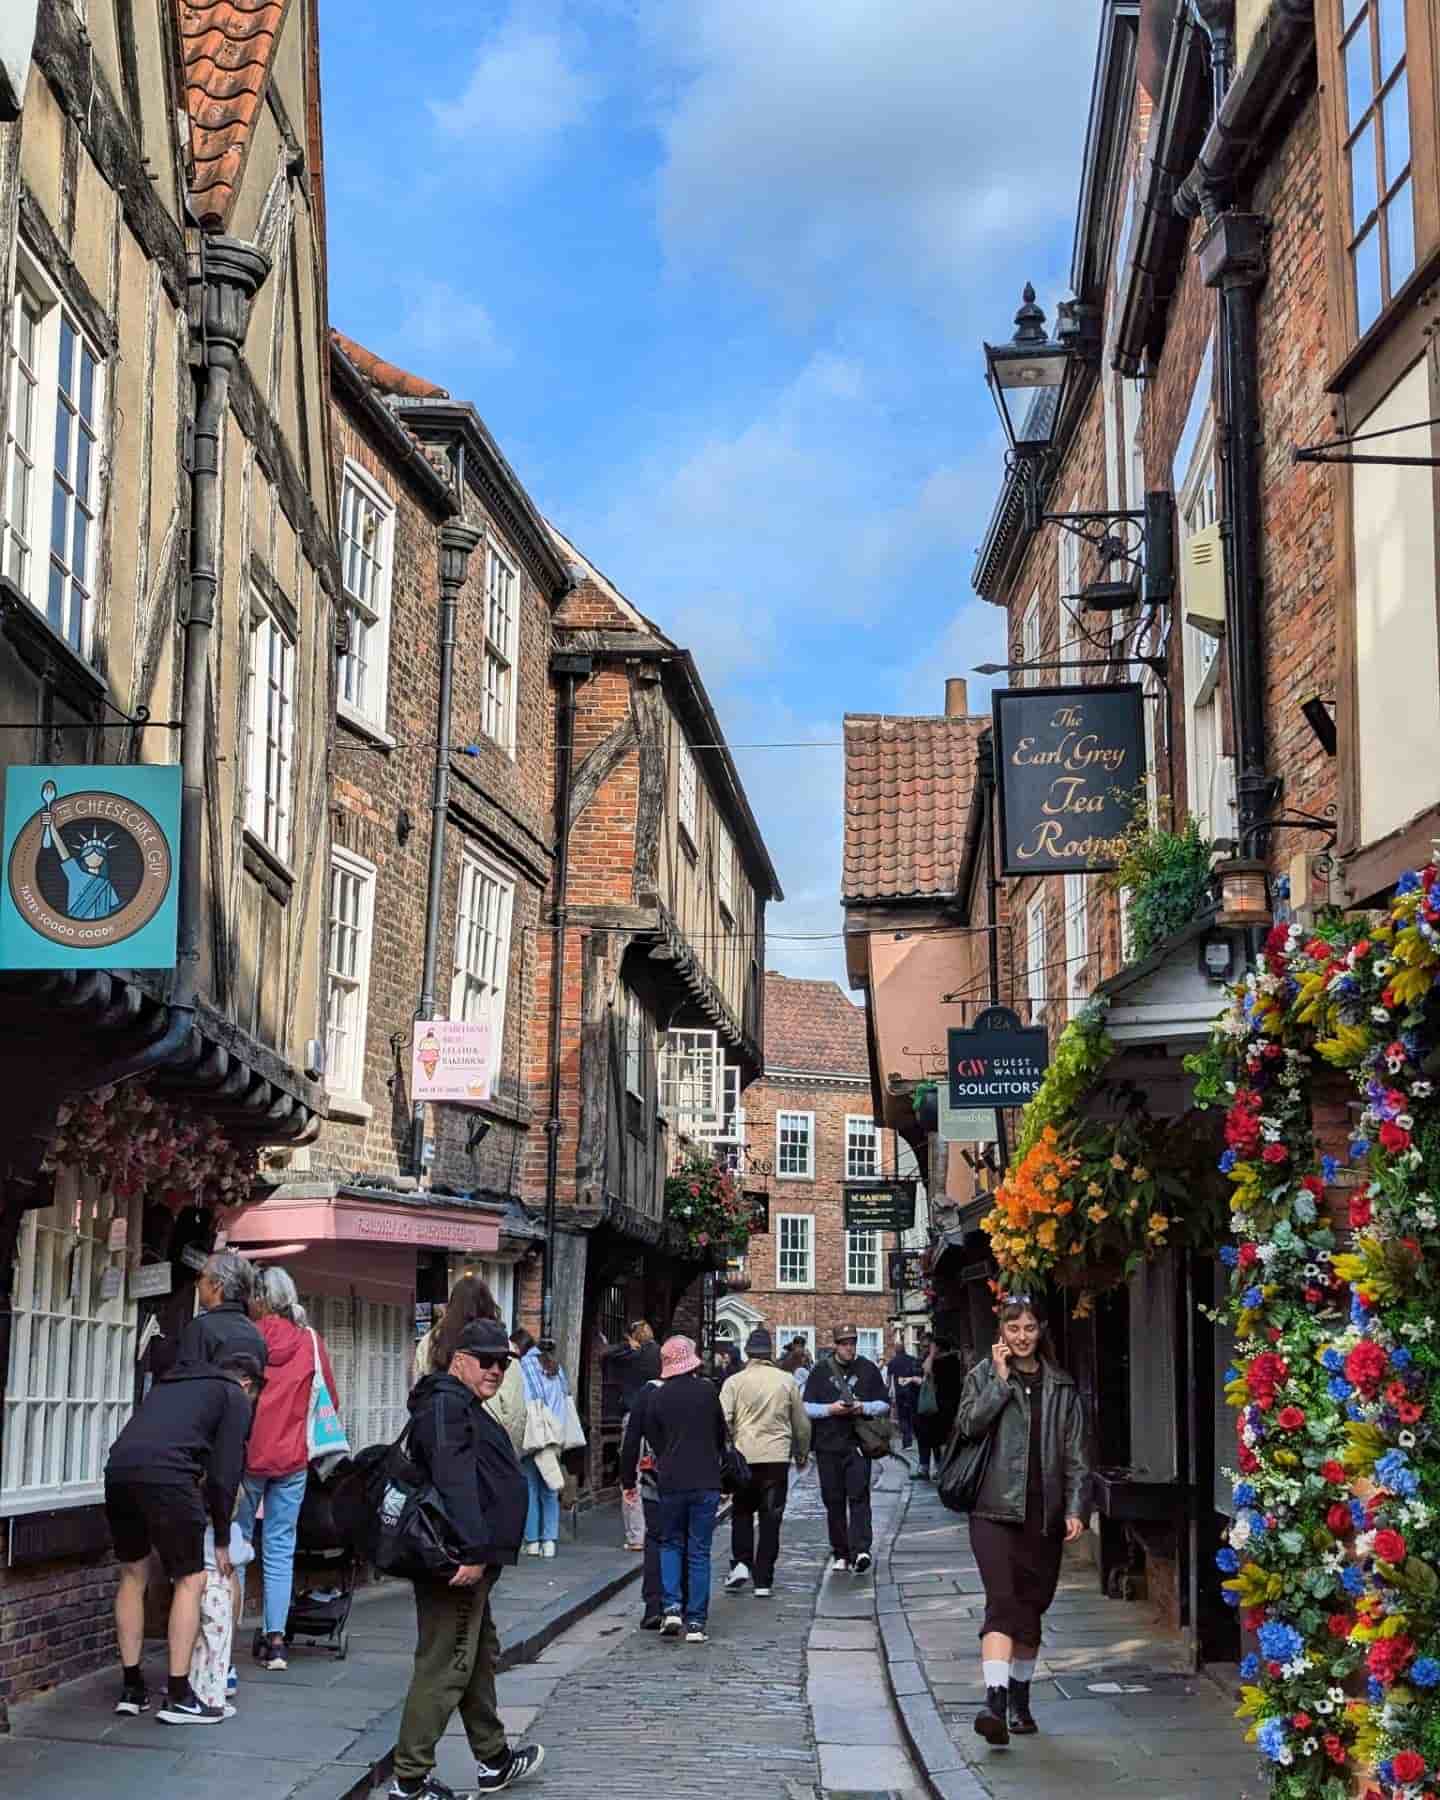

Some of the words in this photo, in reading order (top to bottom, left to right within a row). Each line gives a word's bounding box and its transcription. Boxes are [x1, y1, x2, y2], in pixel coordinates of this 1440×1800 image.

[1049, 705, 1083, 728] The
[1012, 731, 1077, 766] Earl
[1064, 735, 1126, 771] Grey
[1041, 777, 1104, 816] Tea
[148, 850, 163, 879] GUY
[993, 1058, 1032, 1066] GUEST
[993, 1068, 1039, 1076] WALKER
[958, 1082, 1039, 1096] SOLICITORS
